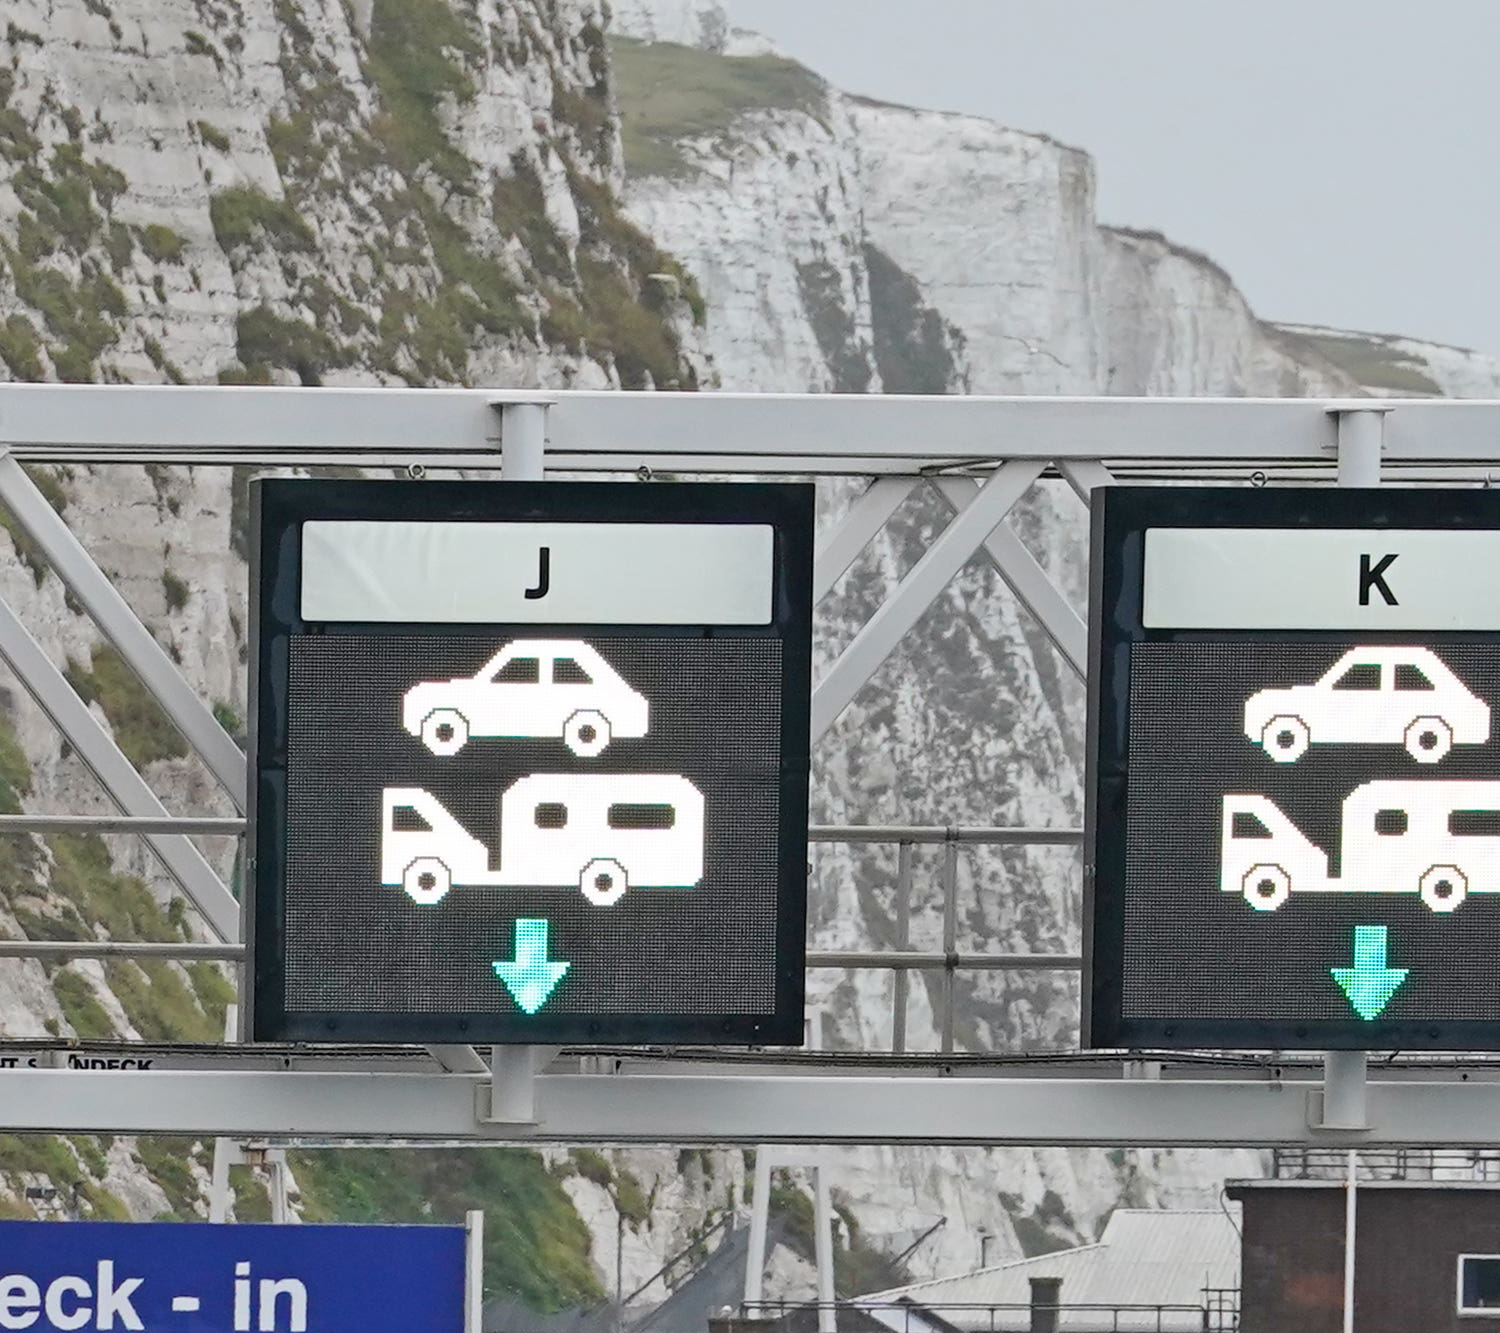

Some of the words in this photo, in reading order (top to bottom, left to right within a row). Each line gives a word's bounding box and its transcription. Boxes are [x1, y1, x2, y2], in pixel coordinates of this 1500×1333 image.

[525, 547, 549, 599] J
[1359, 554, 1398, 605] K
[234, 1261, 308, 1333] in
